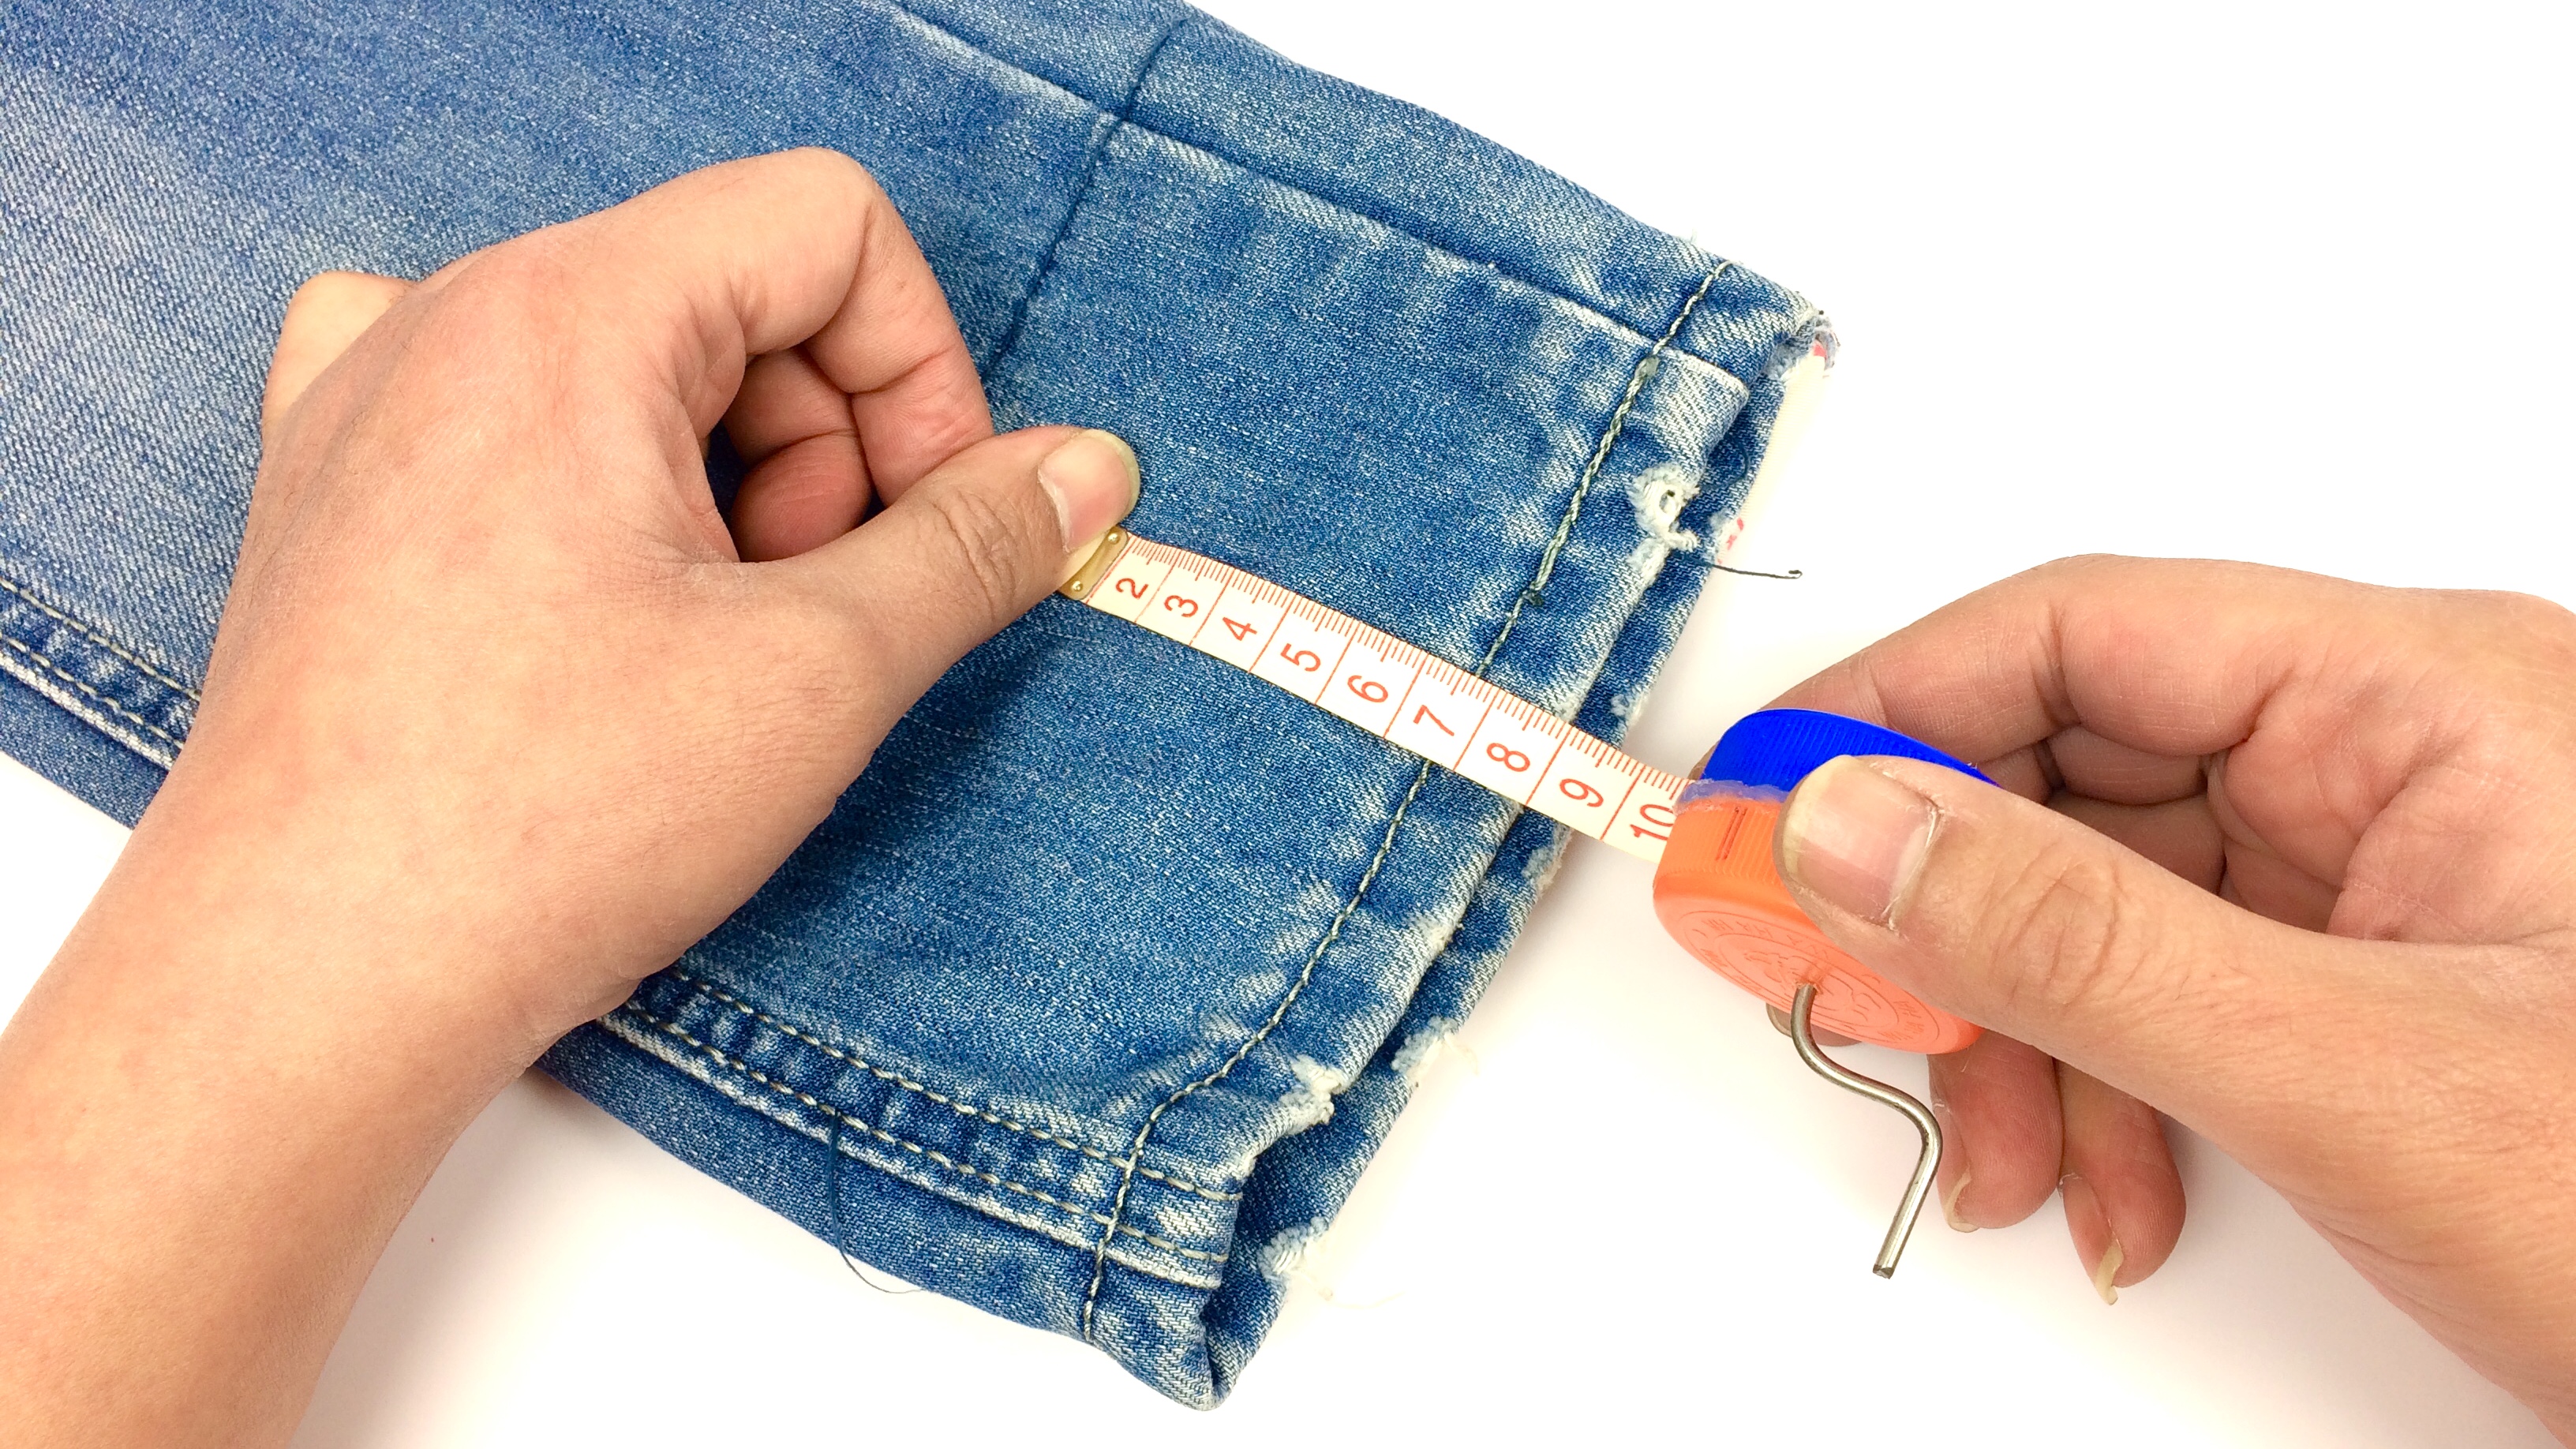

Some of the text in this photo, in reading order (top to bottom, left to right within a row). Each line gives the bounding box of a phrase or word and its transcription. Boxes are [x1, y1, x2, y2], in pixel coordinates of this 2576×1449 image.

[1114, 577, 1674, 842] 2 3 4 5 6 7 8 9 10
